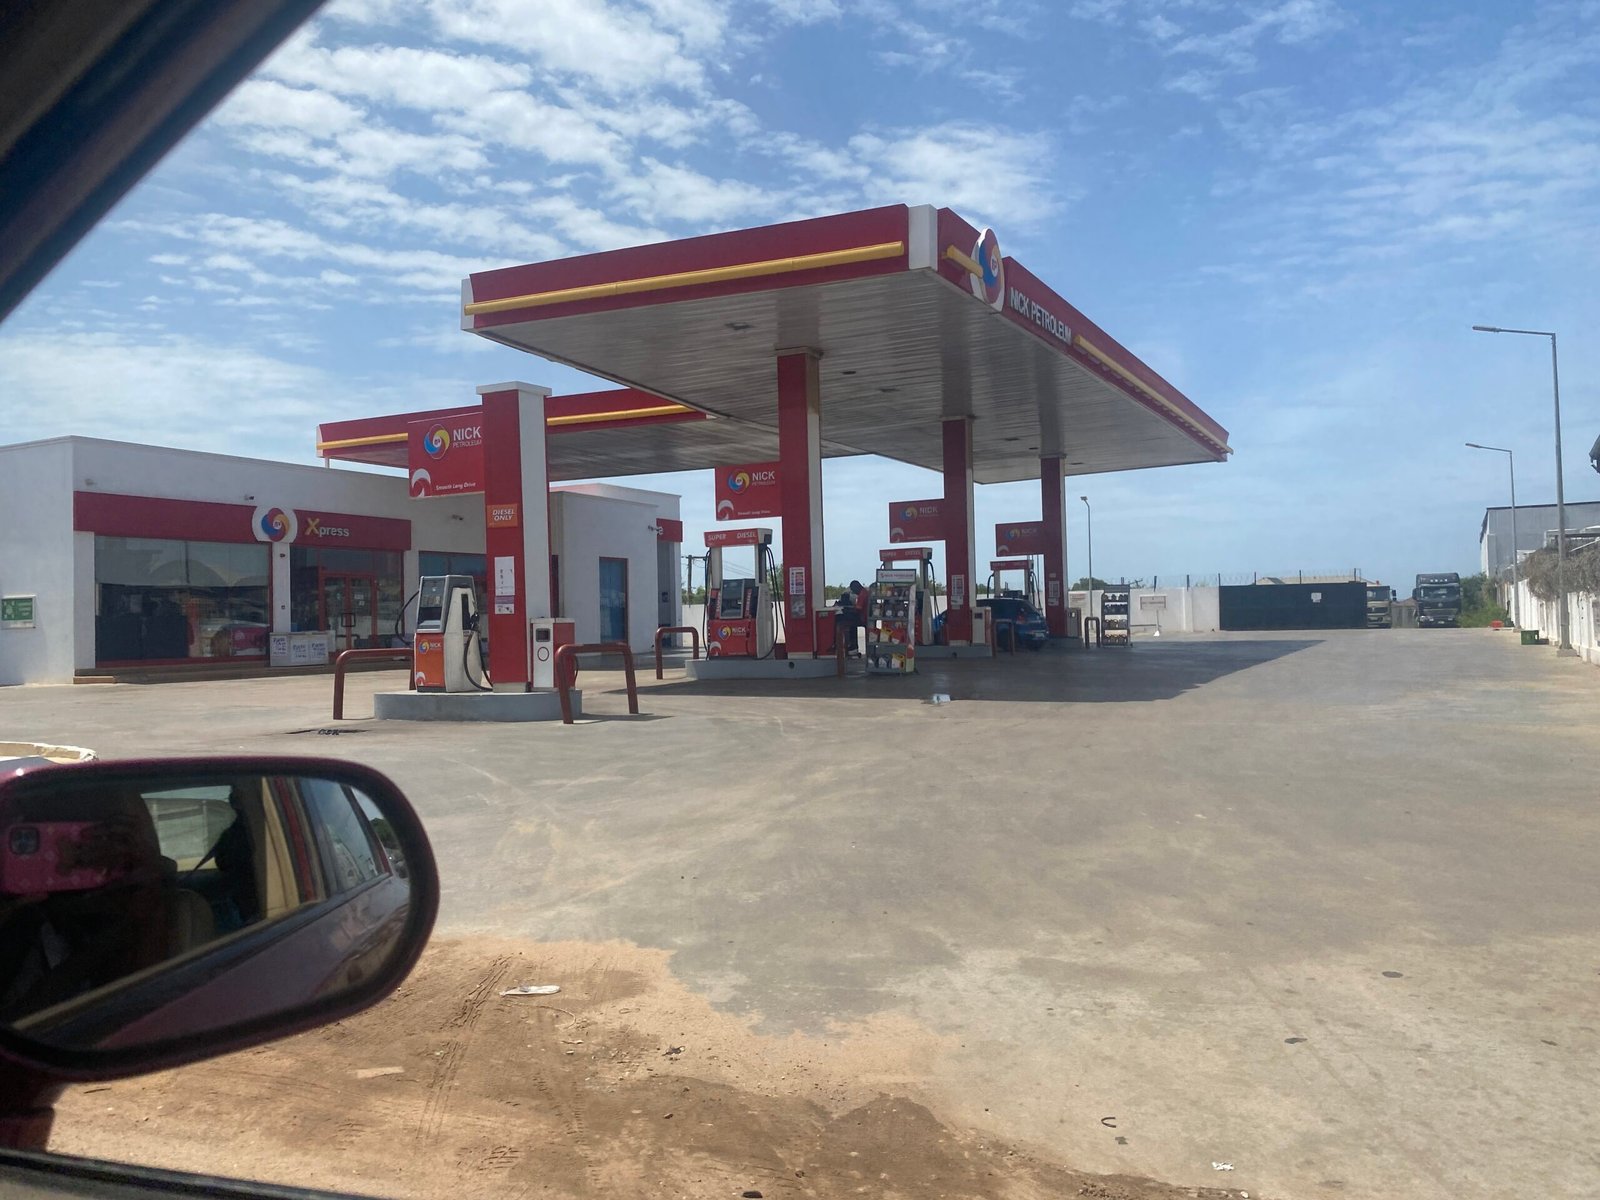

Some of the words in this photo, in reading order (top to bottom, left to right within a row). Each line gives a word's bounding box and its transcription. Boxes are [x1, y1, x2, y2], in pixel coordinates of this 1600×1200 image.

[1010, 286, 1030, 319] NICK
[1031, 300, 1072, 346] PETROLEUM
[453, 426, 482, 441] NICK
[752, 471, 775, 481] NICK
[304, 518, 350, 537] Xpress
[708, 533, 727, 541] SUPER
[737, 531, 757, 539] DIESEL
